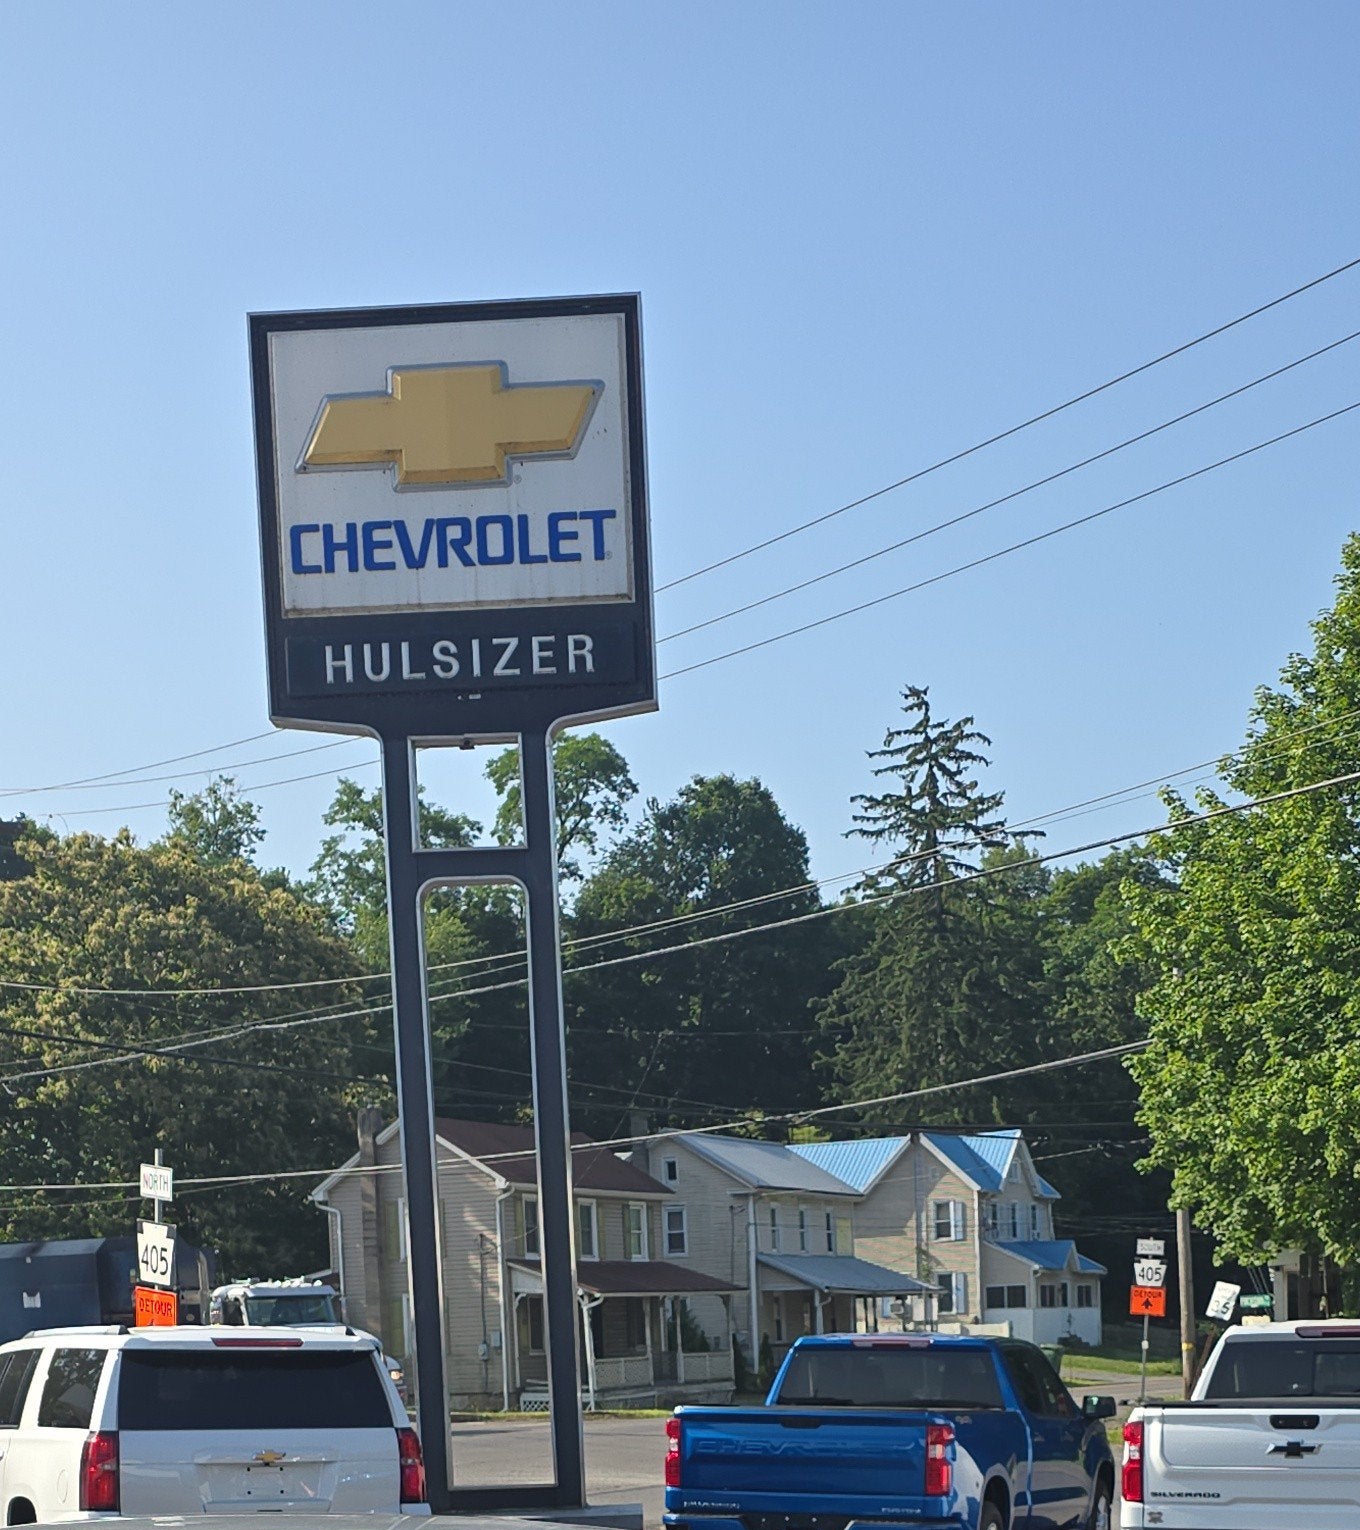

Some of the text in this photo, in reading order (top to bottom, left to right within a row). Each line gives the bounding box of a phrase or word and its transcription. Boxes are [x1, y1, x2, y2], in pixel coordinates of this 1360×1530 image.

[290, 510, 616, 574] CHEVROLET
[325, 634, 596, 684] HULSIZER
[143, 1173, 169, 1192] NORTH
[141, 1244, 168, 1276] 405
[1139, 1267, 1161, 1281] 405
[1134, 1290, 1162, 1298] DETOUR
[140, 1298, 173, 1317] DETOUR
